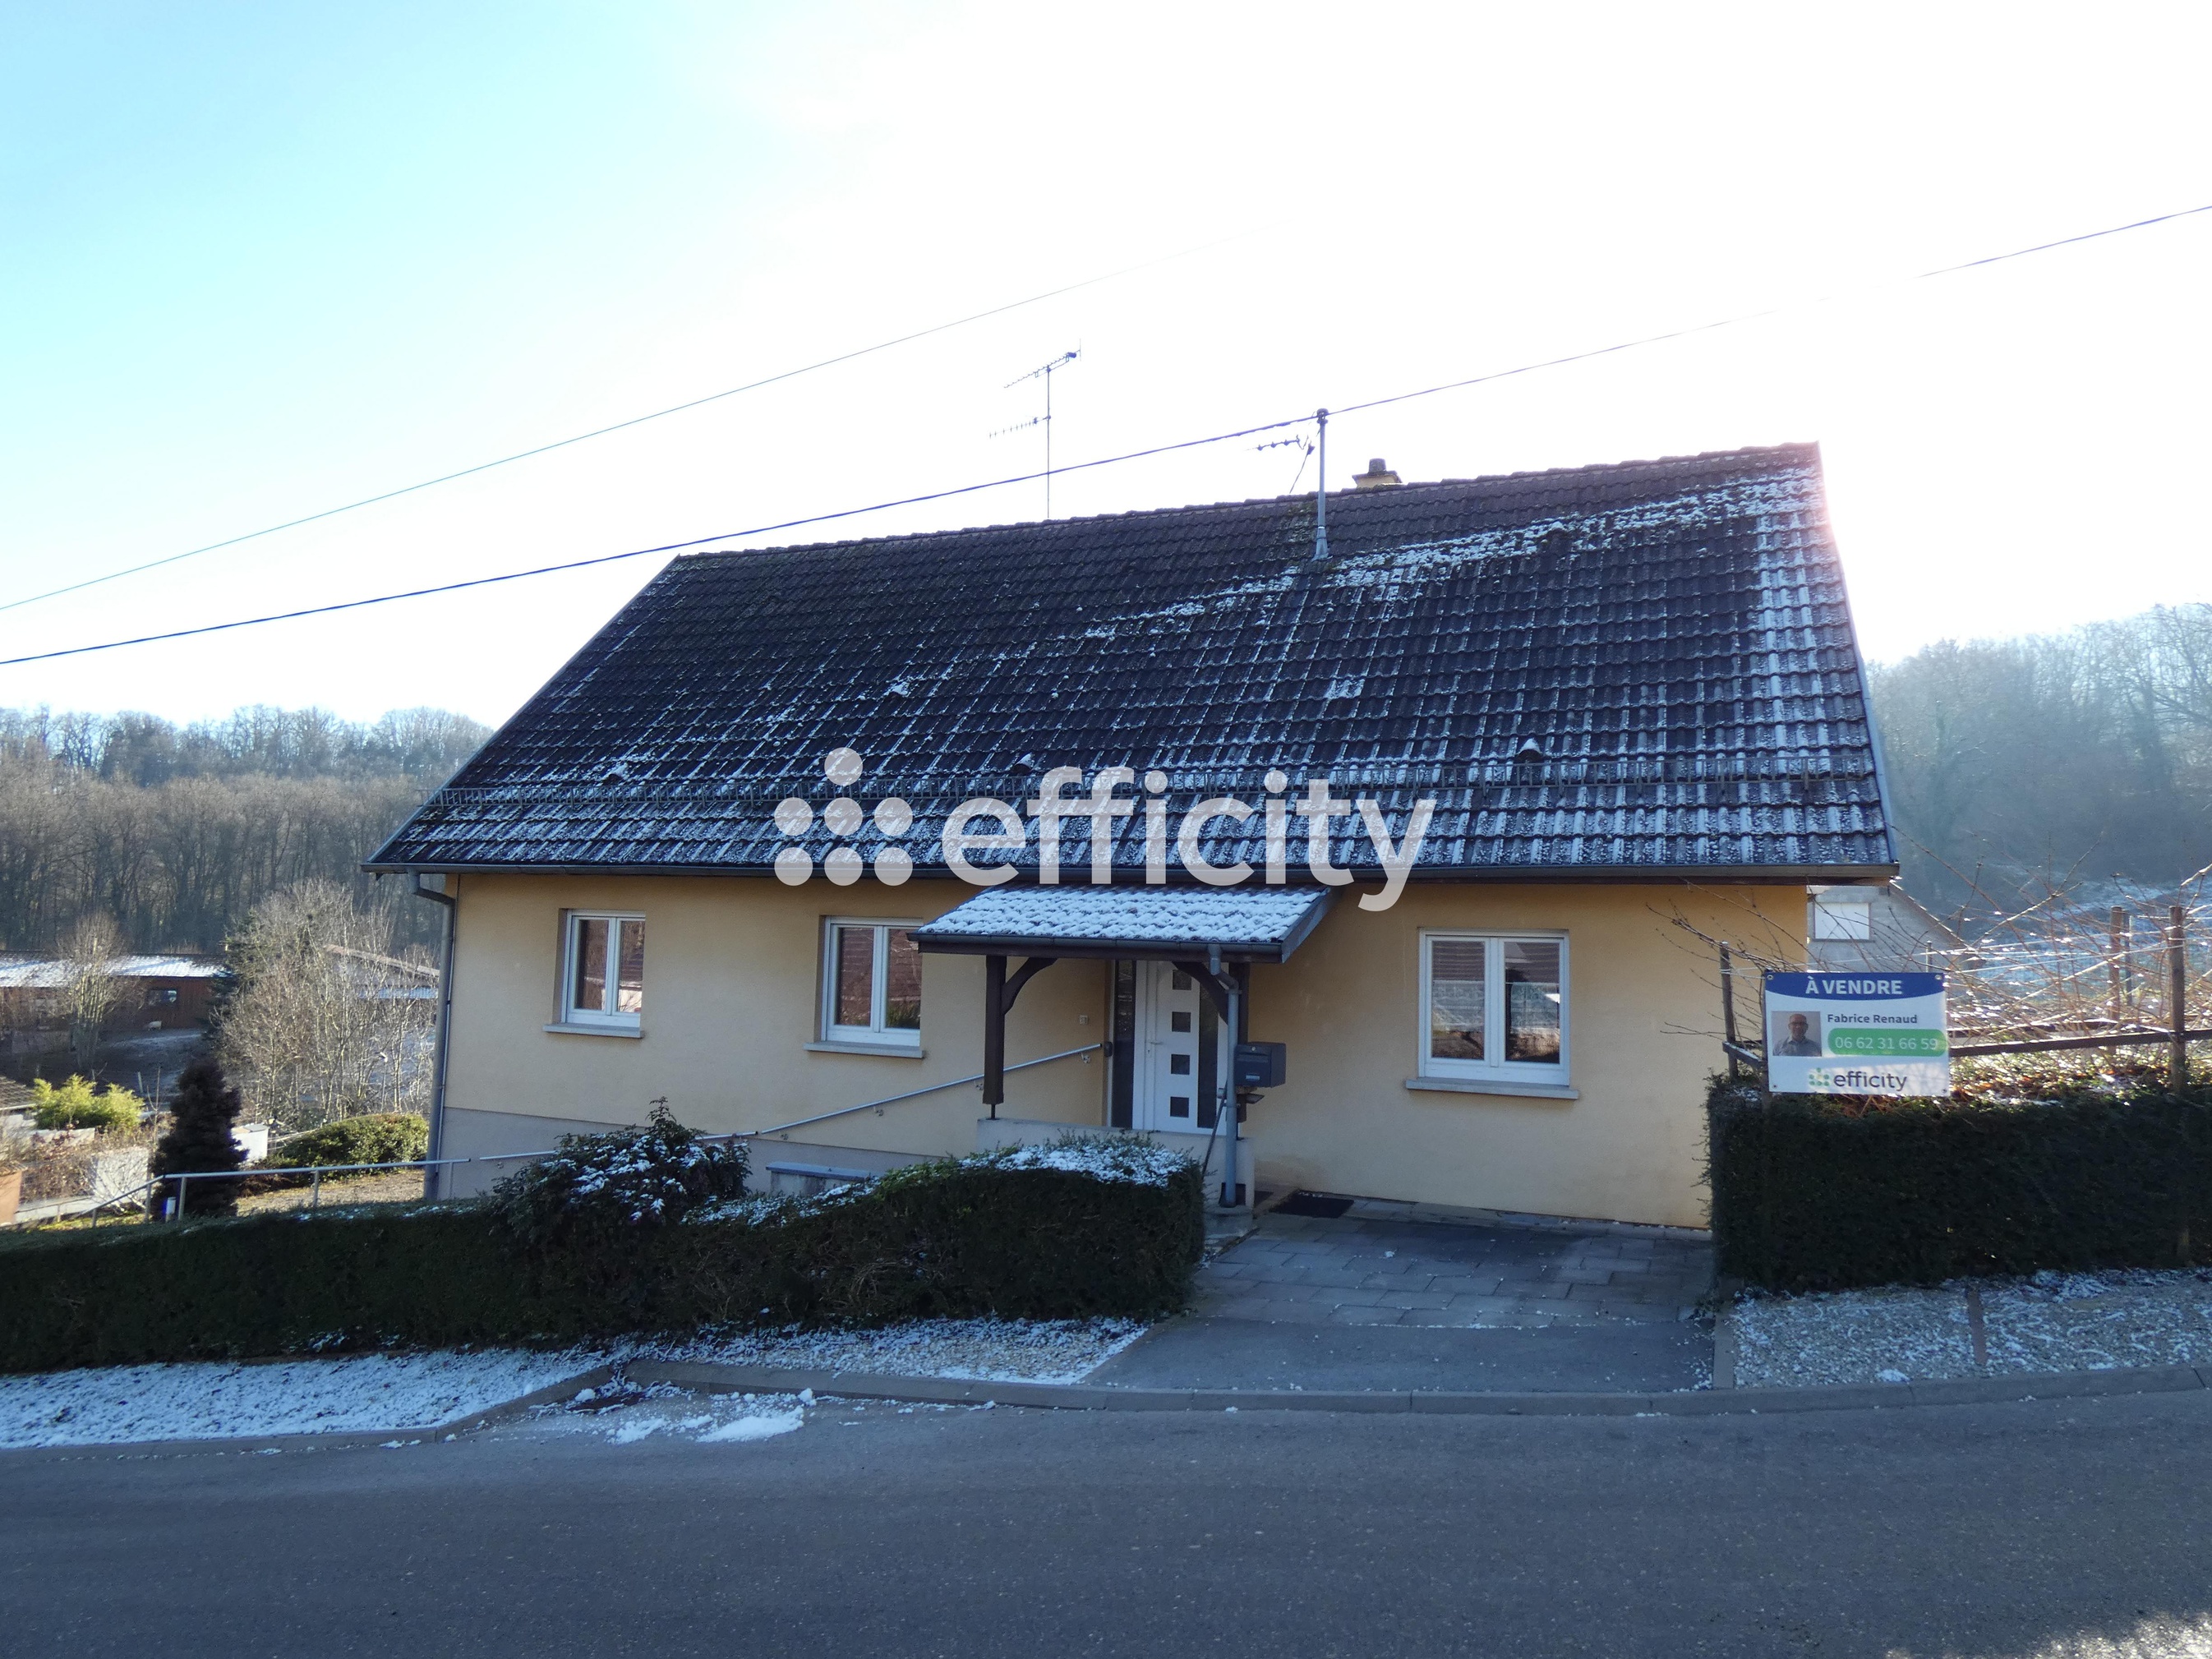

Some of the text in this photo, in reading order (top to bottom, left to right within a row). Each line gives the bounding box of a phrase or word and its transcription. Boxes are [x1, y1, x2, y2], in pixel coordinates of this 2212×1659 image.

[1805, 975, 1903, 995] À VENDRE
[1827, 1014, 1918, 1024] Fabrice Renaud
[1835, 1036, 1938, 1050] 06 62 31 66 59
[1833, 1071, 1908, 1092] efficity
